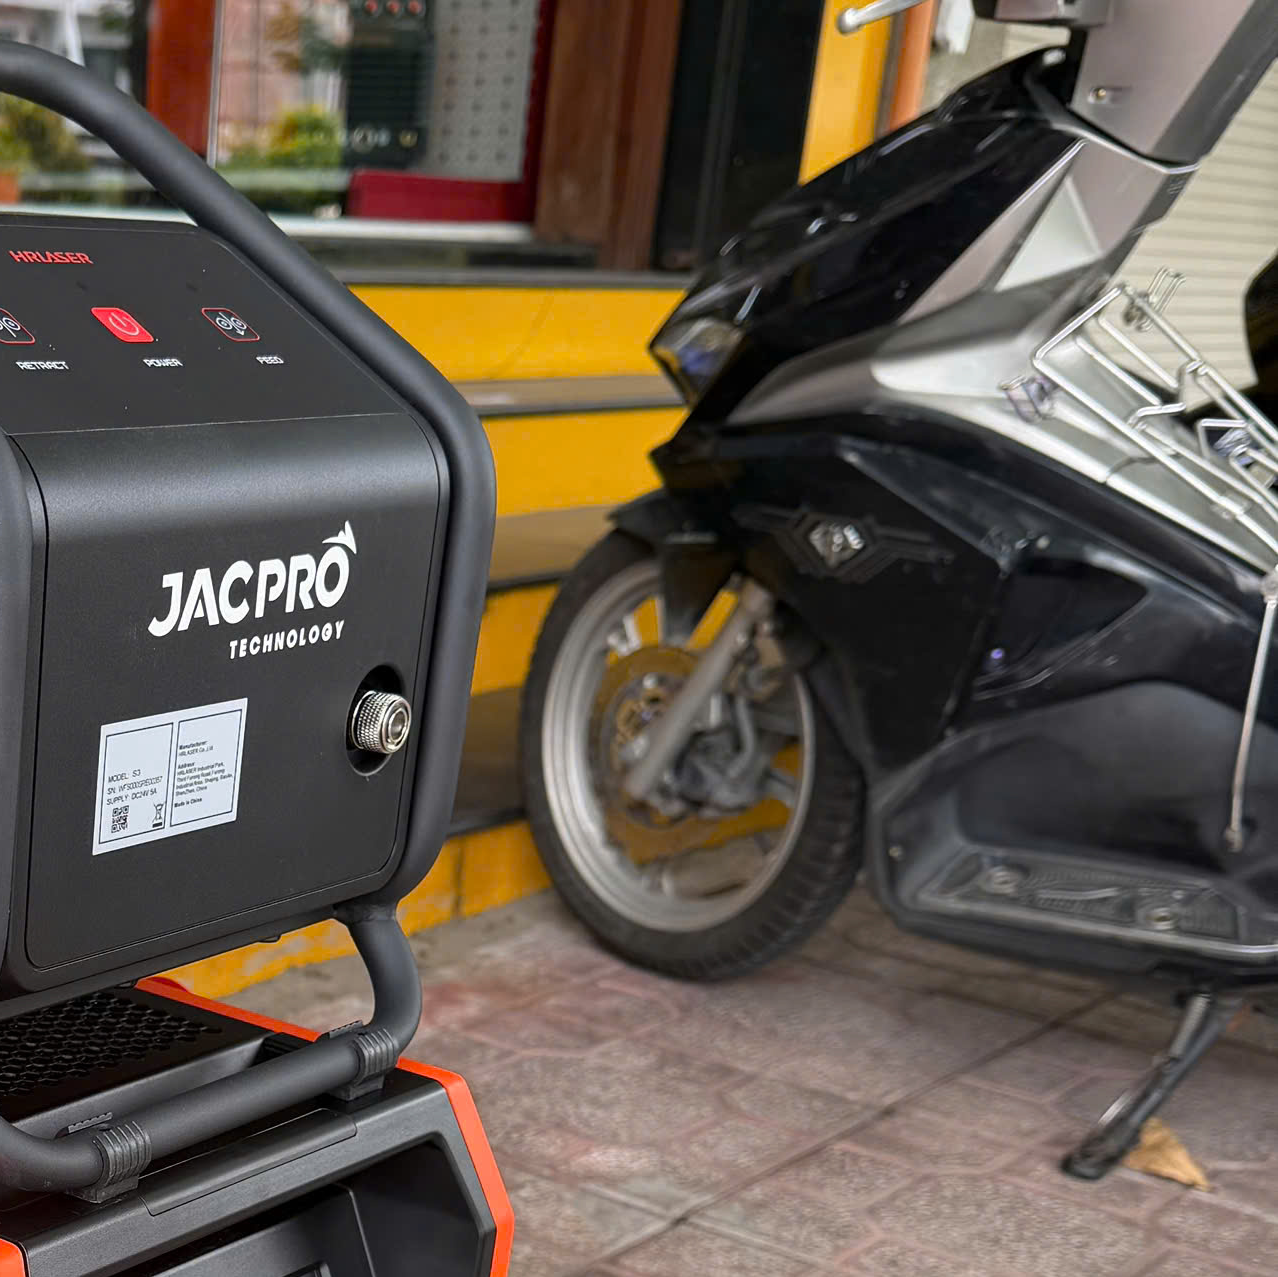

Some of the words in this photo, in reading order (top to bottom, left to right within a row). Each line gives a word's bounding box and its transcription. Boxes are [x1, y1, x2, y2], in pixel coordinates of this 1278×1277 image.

[9, 250, 93, 264] HRLASER
[16, 361, 71, 370] RETRACT
[143, 357, 183, 367] POWER
[256, 355, 284, 364] FEED
[148, 545, 350, 637] JACPRO
[229, 620, 345, 660] TECHNOLOGY
